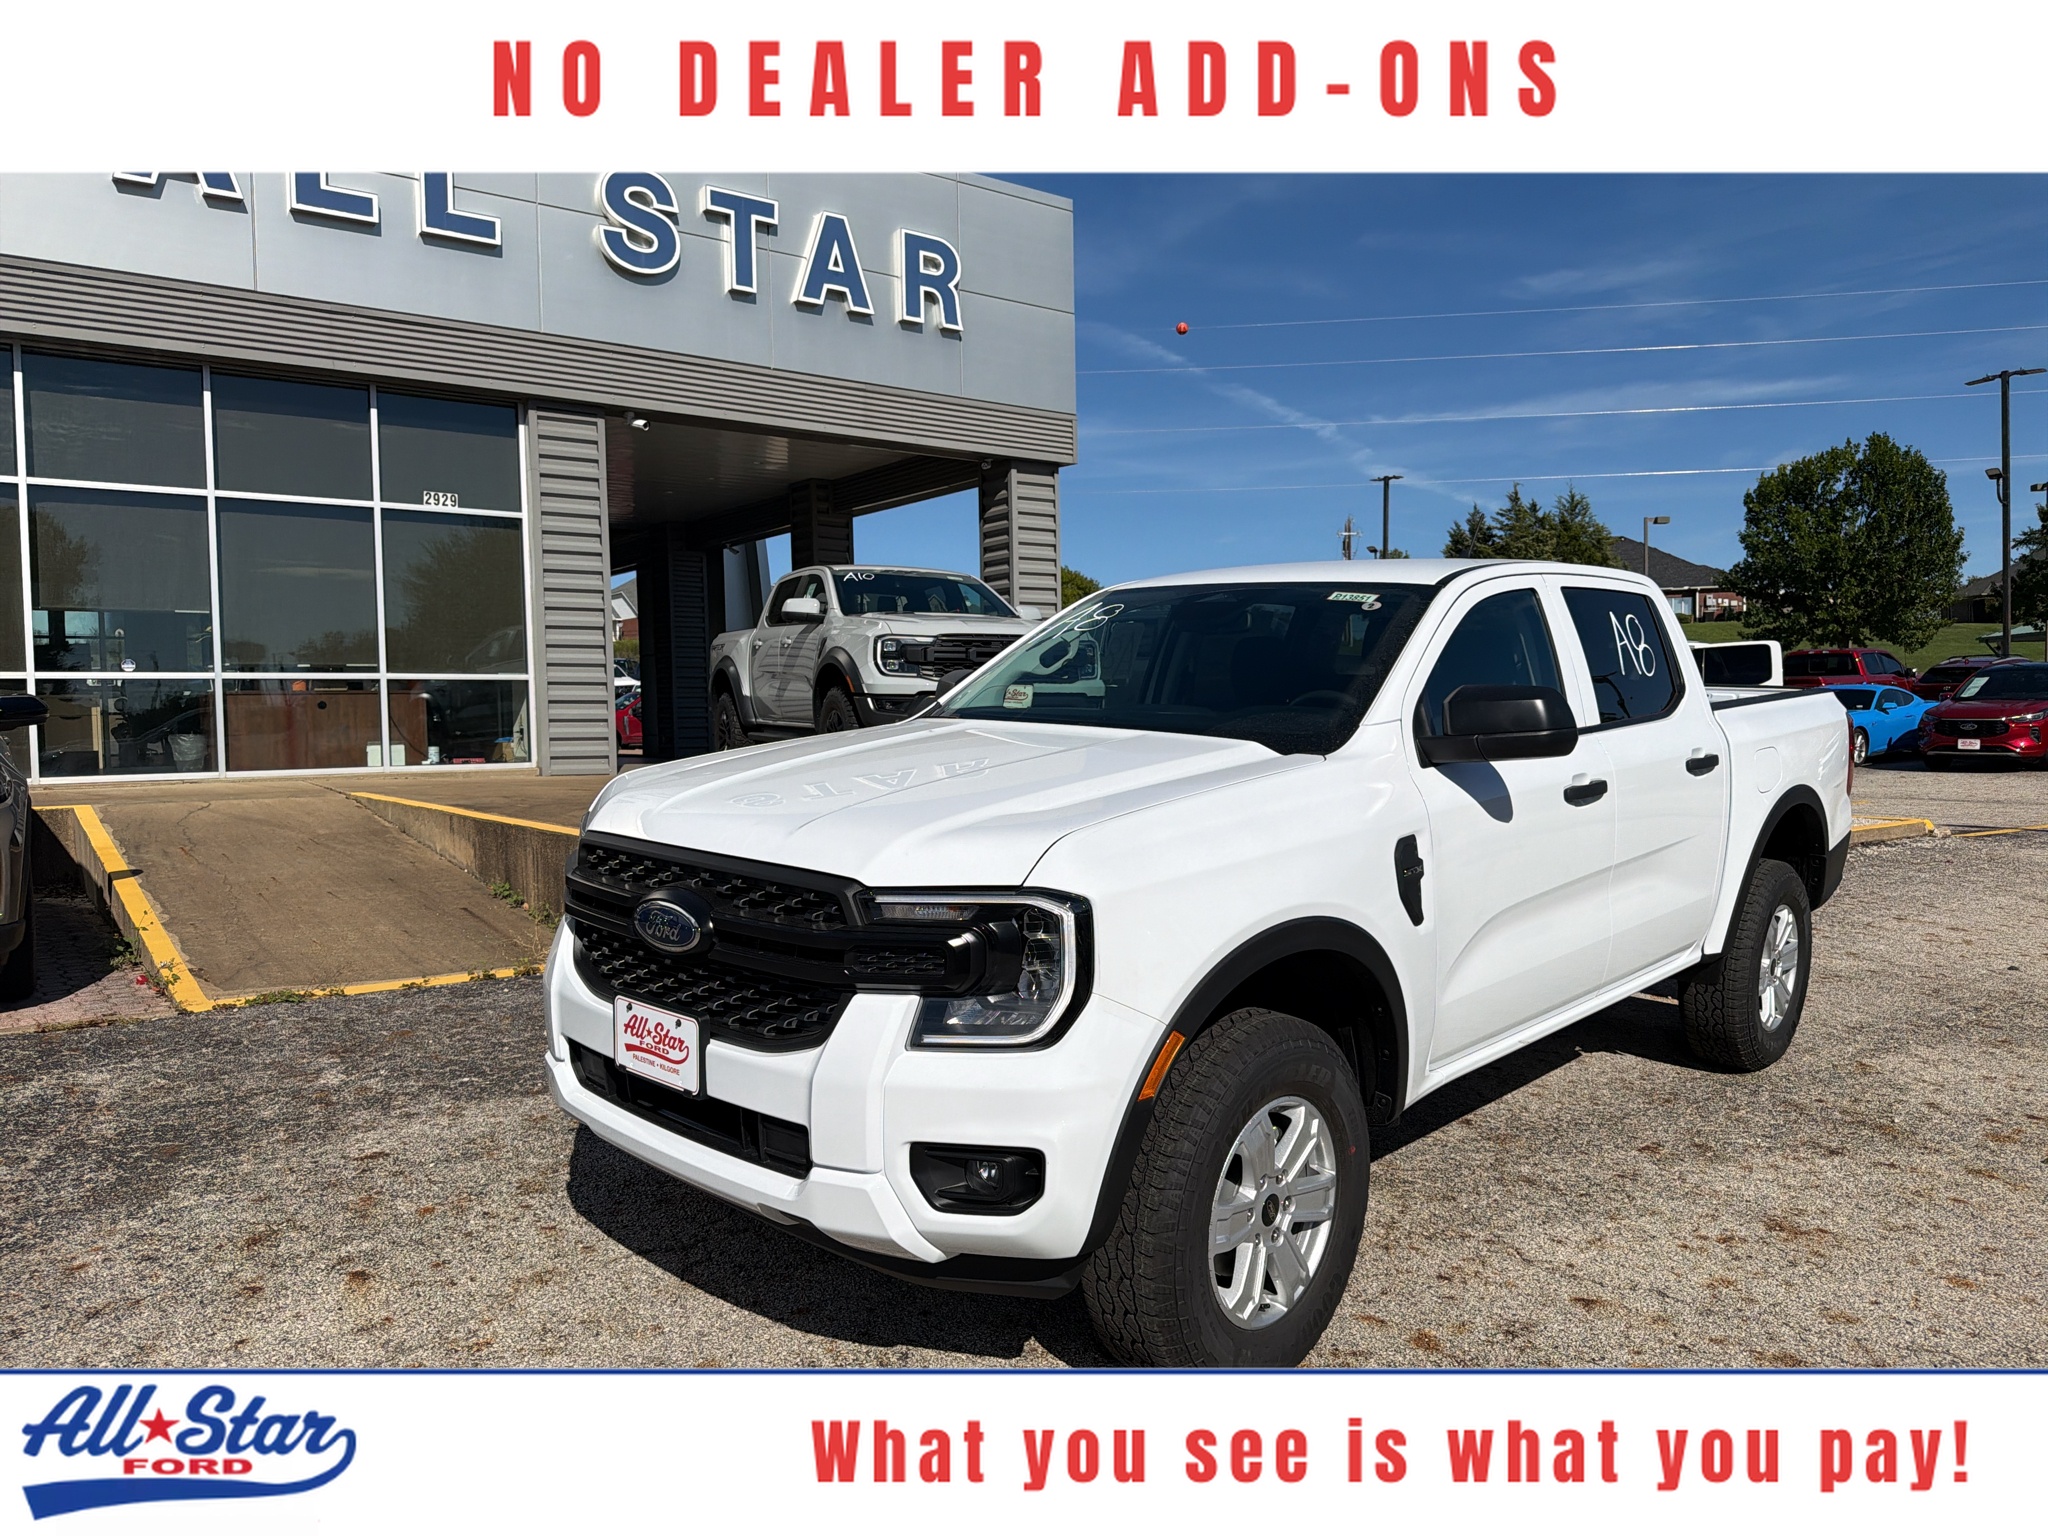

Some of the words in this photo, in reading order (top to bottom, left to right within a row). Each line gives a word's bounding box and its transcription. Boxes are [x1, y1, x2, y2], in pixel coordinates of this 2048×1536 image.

[111, 172, 500, 246] LL
[598, 172, 963, 331] STAR
[425, 491, 457, 507] 2929
[1609, 611, 1656, 677] A8
[645, 909, 682, 941] Ford
[623, 1014, 649, 1040] All
[652, 1021, 687, 1053] Star
[639, 1039, 670, 1055] FORD
[632, 1053, 656, 1067] PALESTINE
[659, 1062, 680, 1076] KILGORE
